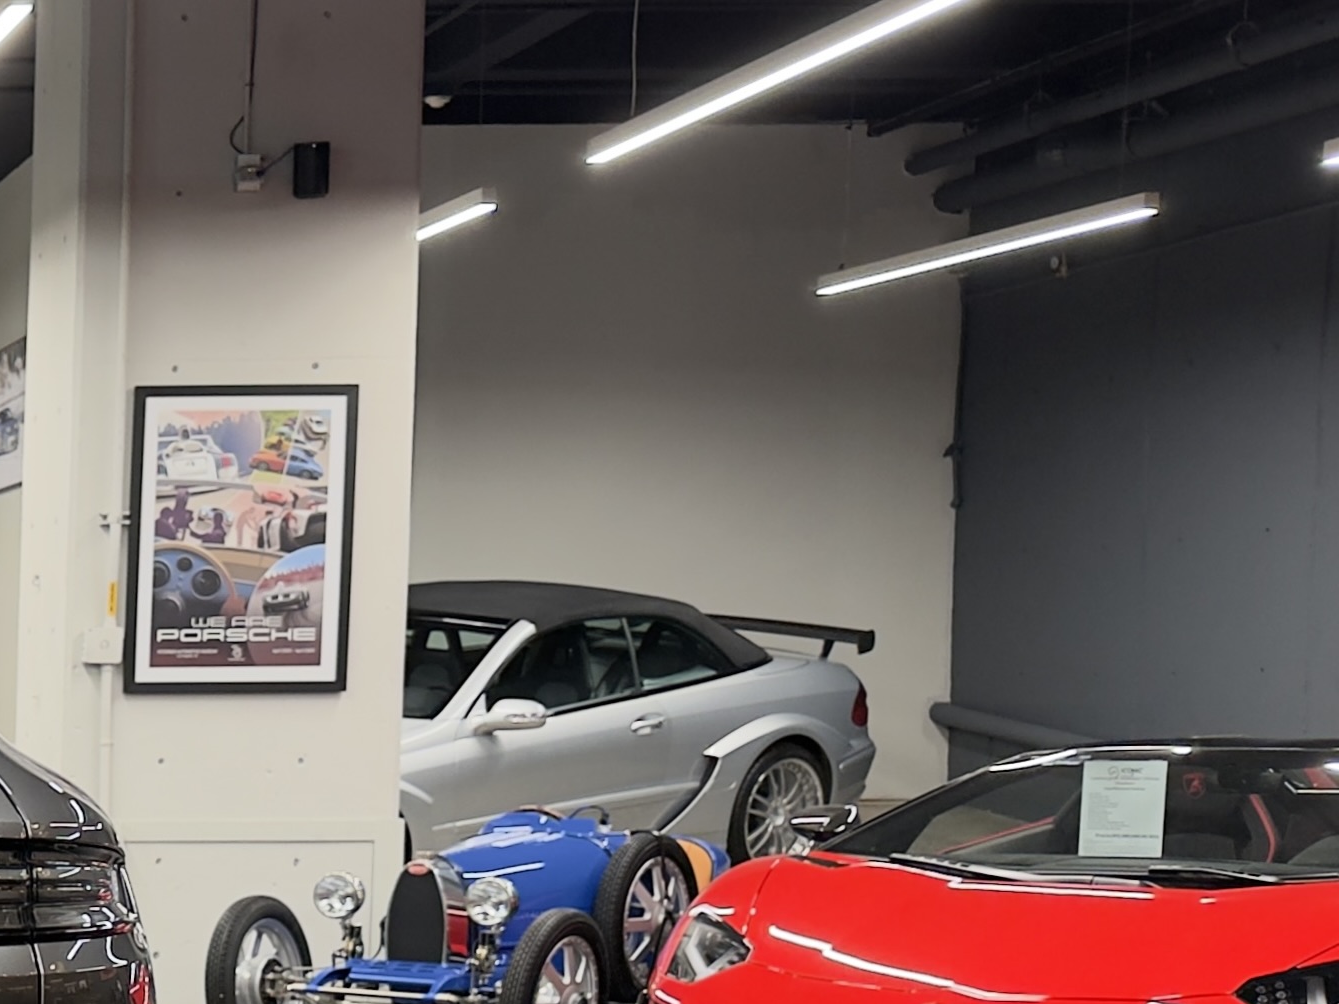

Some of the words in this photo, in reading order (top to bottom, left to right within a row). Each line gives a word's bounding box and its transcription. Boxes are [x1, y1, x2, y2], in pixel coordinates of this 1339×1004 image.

[191, 616, 226, 627] WE
[231, 615, 283, 628] ARE
[156, 627, 316, 643] PORSCHE
